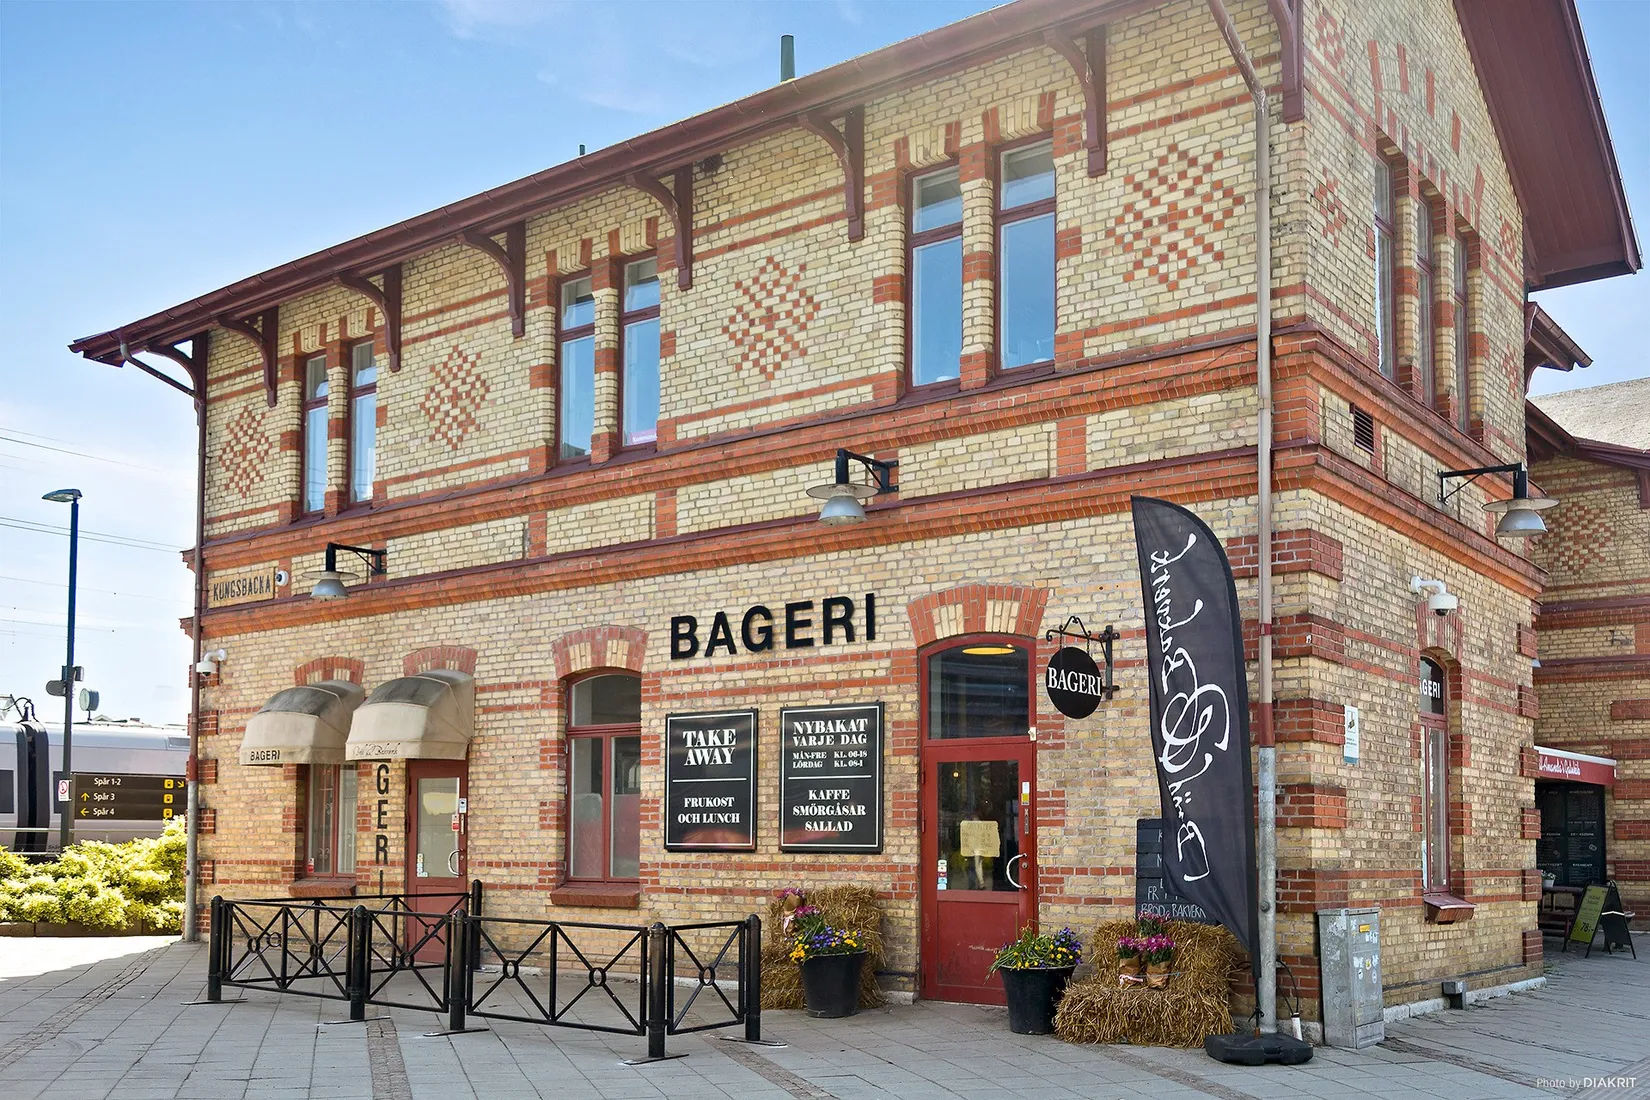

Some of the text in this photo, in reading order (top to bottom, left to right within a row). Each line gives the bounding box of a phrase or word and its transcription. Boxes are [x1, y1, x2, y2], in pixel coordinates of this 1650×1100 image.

[213, 574, 271, 600] KUNGSBACKA
[670, 593, 876, 660] BAGERI
[1047, 666, 1102, 697] BAGERI
[792, 718, 868, 735] NYBAKAT
[682, 728, 737, 748] TAKE
[792, 733, 868, 747] VARJE DAG
[250, 750, 281, 762] BAGERI
[684, 747, 735, 767] AWAY
[792, 750, 827, 760] MÅN-FRE
[848, 750, 868, 758] 06-18
[792, 759, 823, 769] LÖRDAG
[94, 777, 110, 786] Spår
[93, 792, 110, 801] Spår
[808, 788, 851, 800] KAFFE
[684, 796, 735, 808] FRUKOST
[93, 807, 109, 816] Spår
[792, 802, 867, 817] SMÖRGÅSAR
[677, 812, 740, 824] OCH LUNCH
[804, 820, 853, 833] SALLAD
